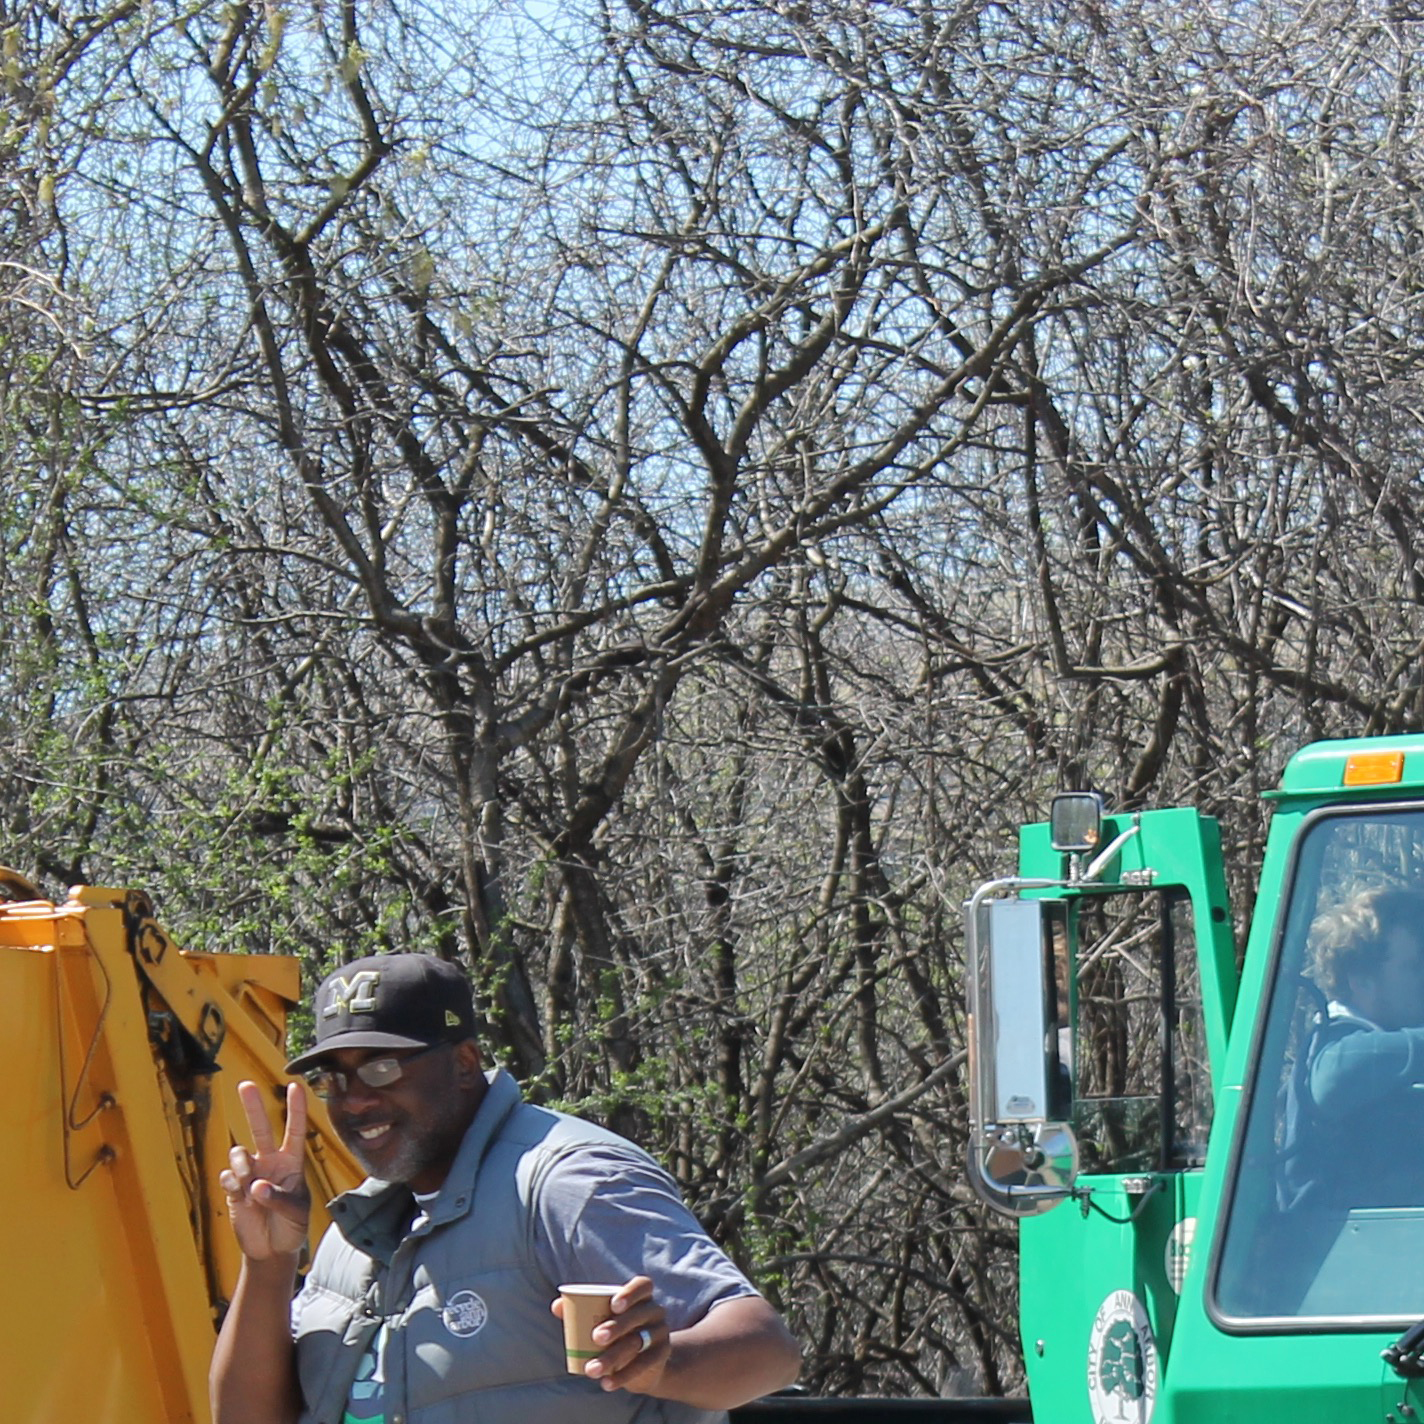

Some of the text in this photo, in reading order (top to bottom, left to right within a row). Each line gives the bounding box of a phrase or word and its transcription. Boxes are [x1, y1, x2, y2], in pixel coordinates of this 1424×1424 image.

[323, 971, 381, 1021] M
[1088, 1345, 1098, 1391] CITY
[1096, 1305, 1107, 1334] OF
[1114, 1291, 1134, 1313] ANN
